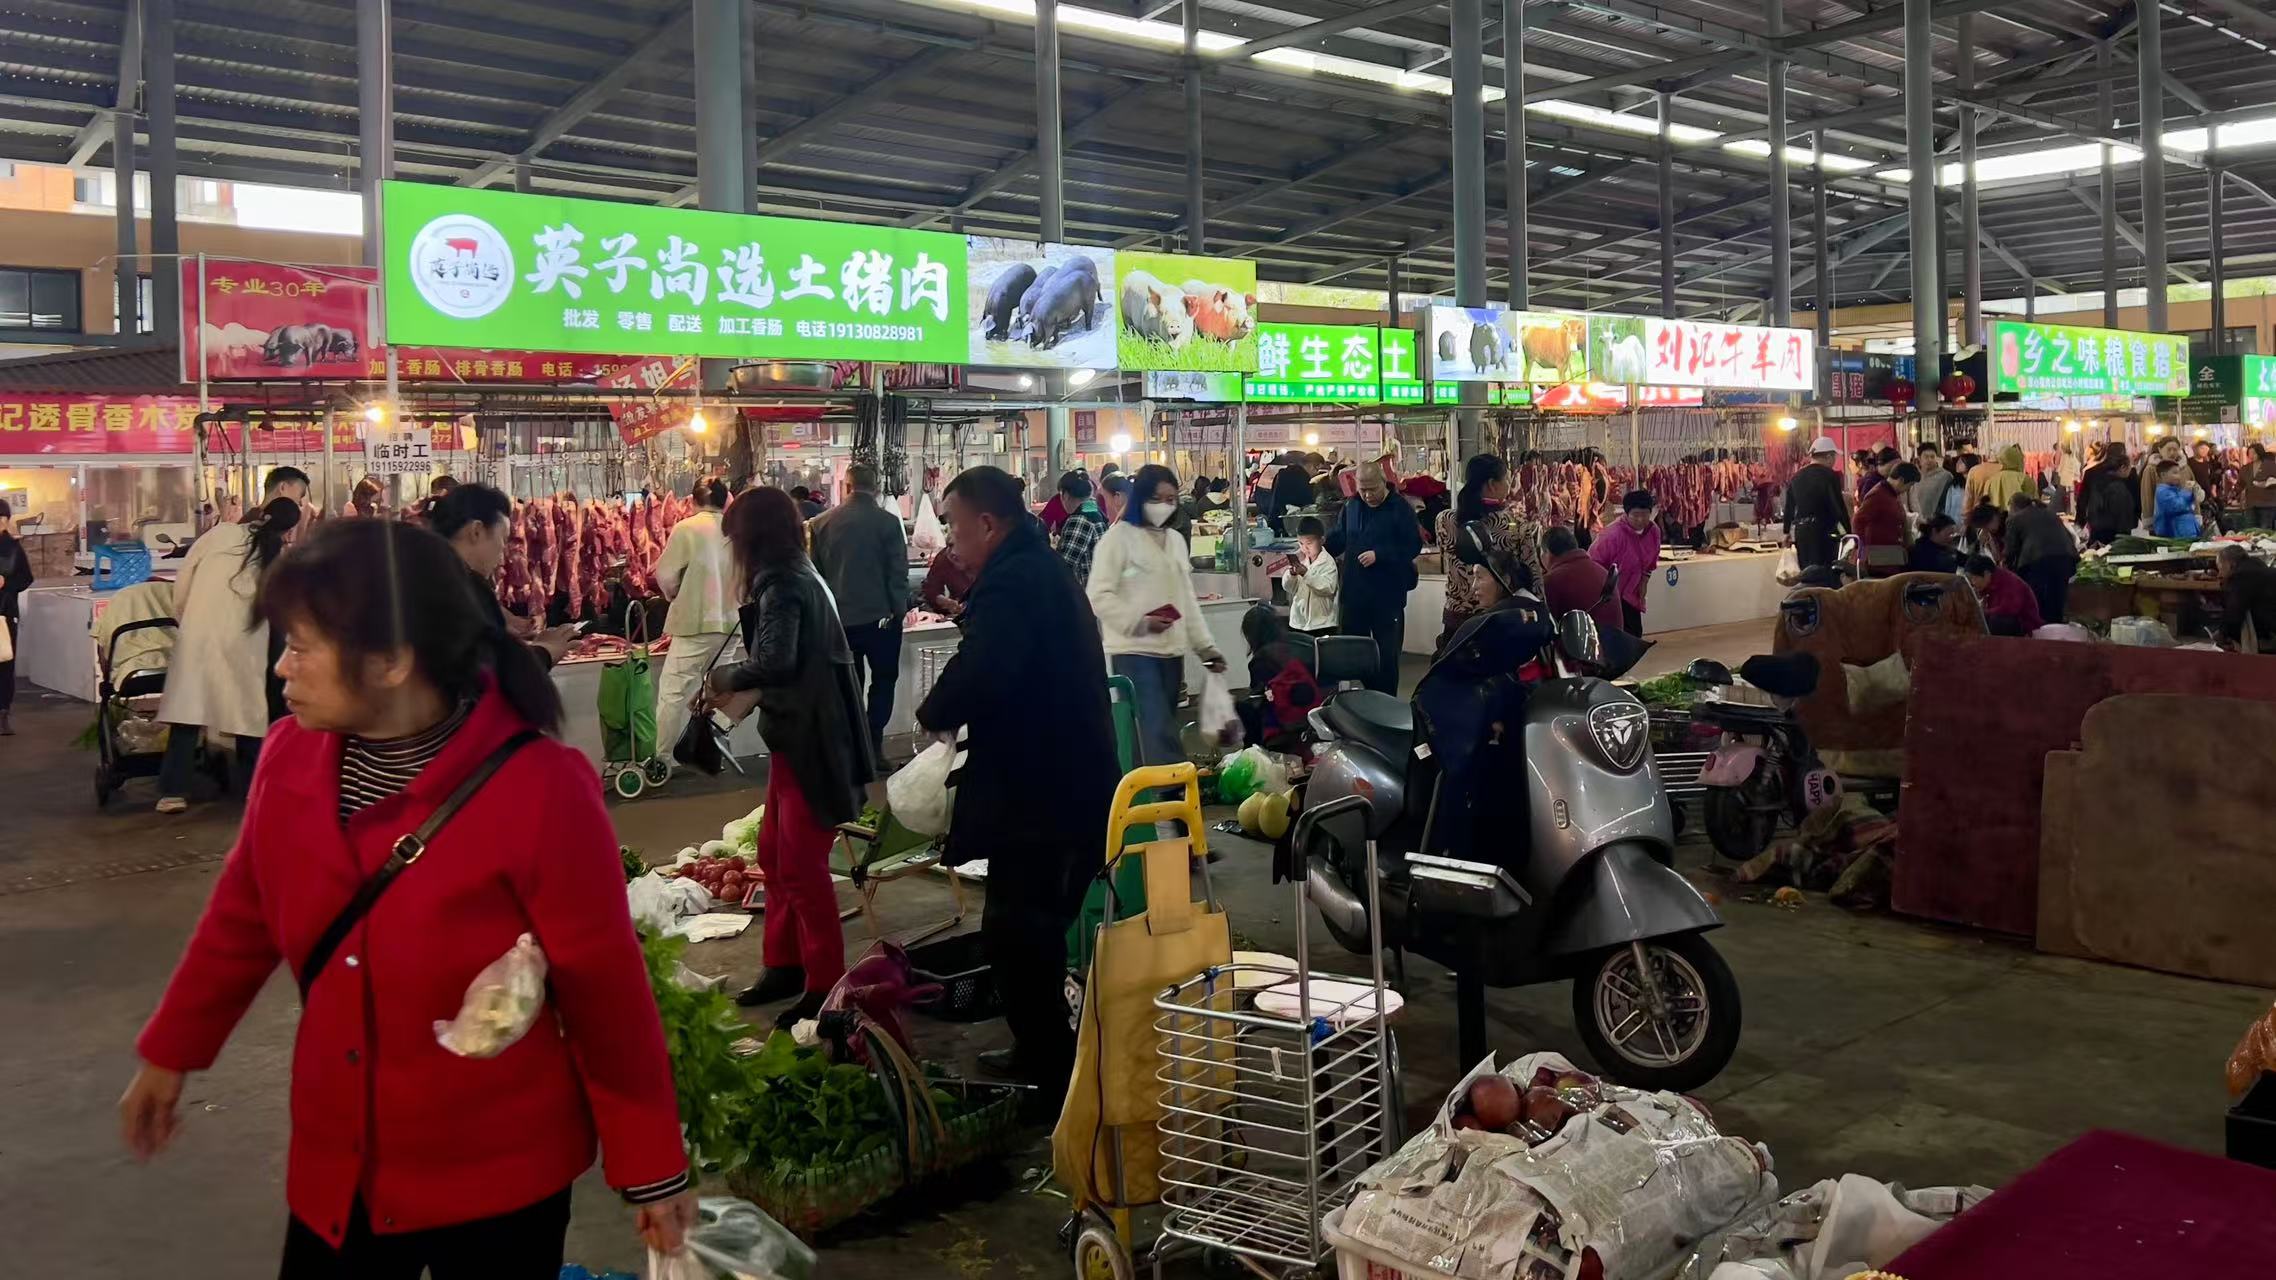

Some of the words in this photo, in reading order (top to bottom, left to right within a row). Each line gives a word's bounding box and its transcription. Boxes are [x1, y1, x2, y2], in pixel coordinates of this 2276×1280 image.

[210, 276, 327, 297] 专业30年
[525, 223, 950, 322] 英子尚选土猪肉
[563, 309, 600, 329] 批发
[617, 311, 653, 331] 零售
[668, 313, 703, 332] 配送
[718, 316, 783, 337] 加工香肠
[1258, 332, 1411, 379] 鲜生态土
[1656, 323, 1803, 382] 刘记牛羊肉
[368, 359, 441, 377] 加香肠
[455, 360, 524, 377] 排骨香肠
[373, 443, 429, 459] 临时工
